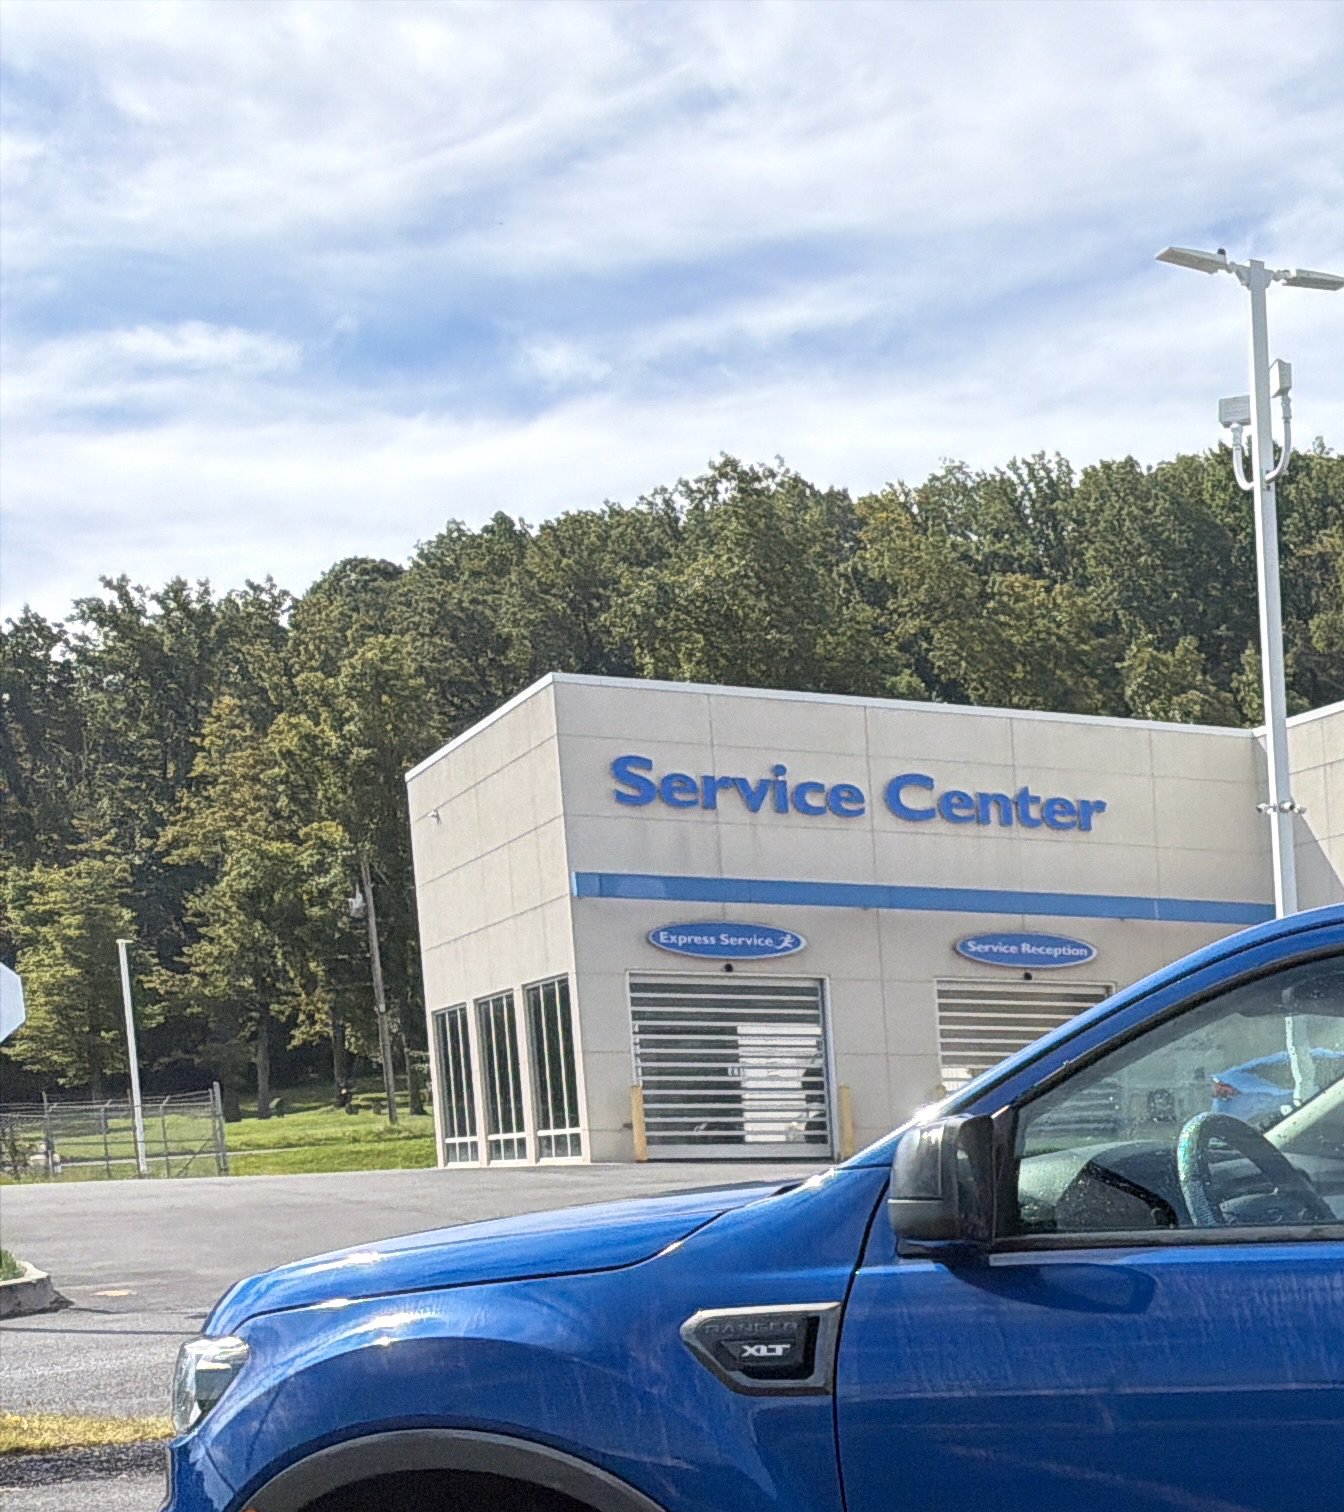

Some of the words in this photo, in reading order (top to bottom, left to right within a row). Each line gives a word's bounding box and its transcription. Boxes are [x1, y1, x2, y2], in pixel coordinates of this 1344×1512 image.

[610, 754, 867, 818] Service
[884, 772, 1107, 831] Center
[659, 931, 716, 947] Express
[720, 933, 774, 948] Service
[967, 940, 1018, 955] Service
[1021, 942, 1088, 958] Reception
[741, 1343, 791, 1357] XLT
